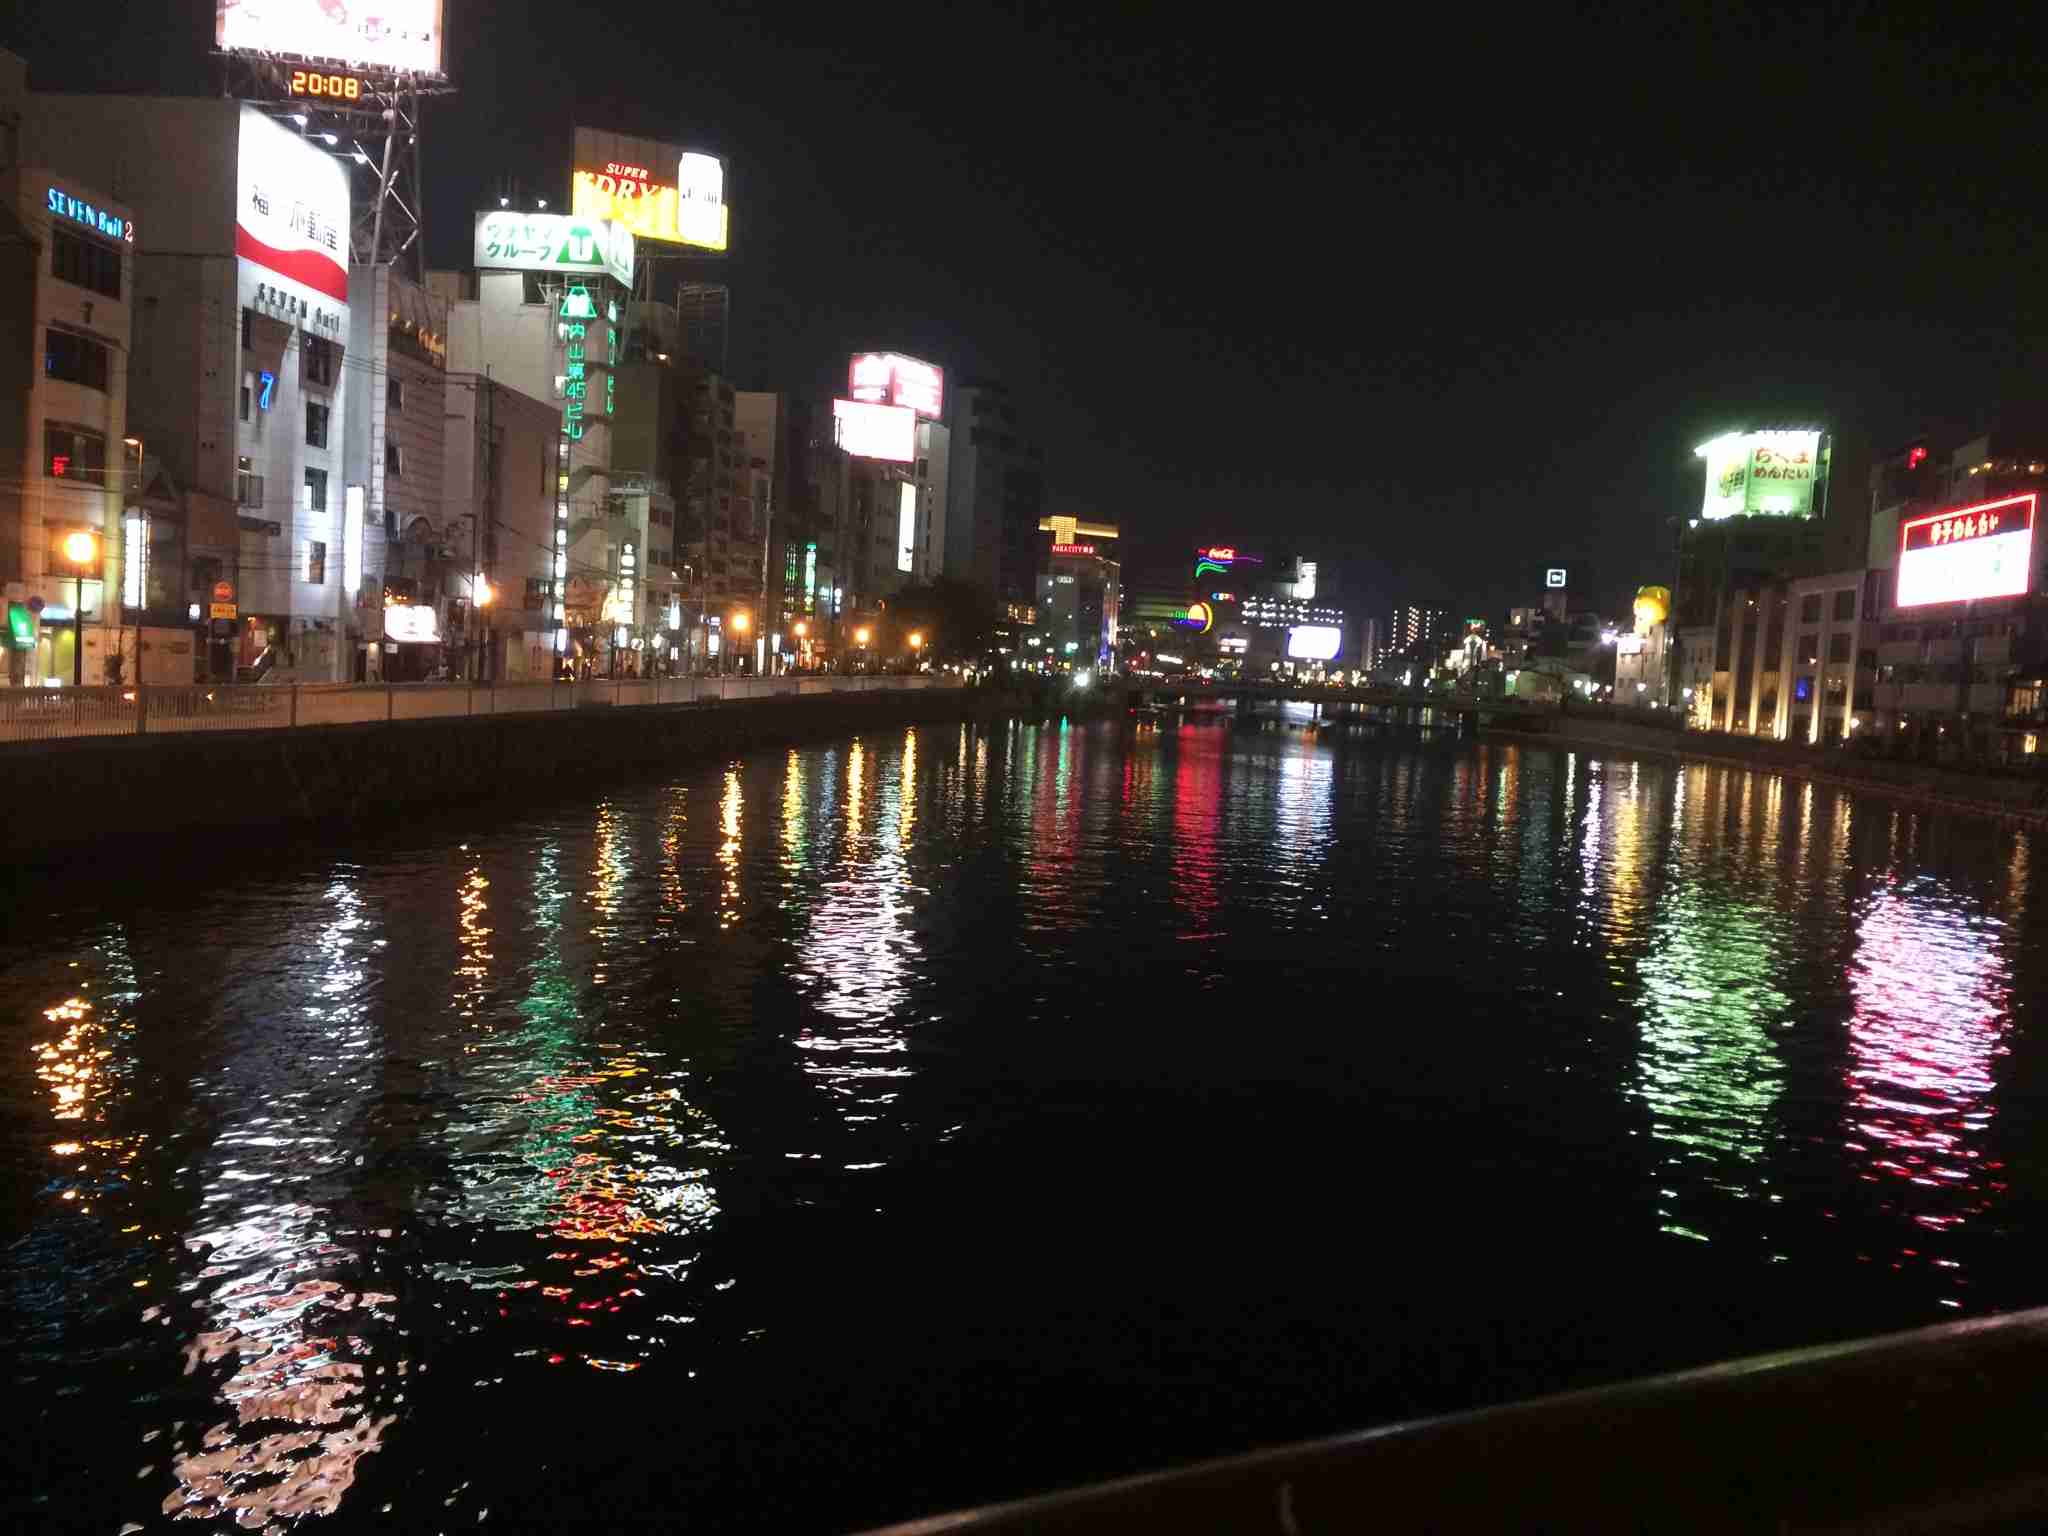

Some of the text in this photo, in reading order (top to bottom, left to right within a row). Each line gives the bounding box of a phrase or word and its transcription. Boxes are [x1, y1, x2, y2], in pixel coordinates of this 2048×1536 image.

[292, 71, 358, 98] 20:08
[606, 162, 648, 180] SUPER
[595, 174, 659, 203] DRY
[48, 188, 96, 226] SEVEN
[125, 221, 134, 242] 2
[256, 282, 307, 319] SEVEN
